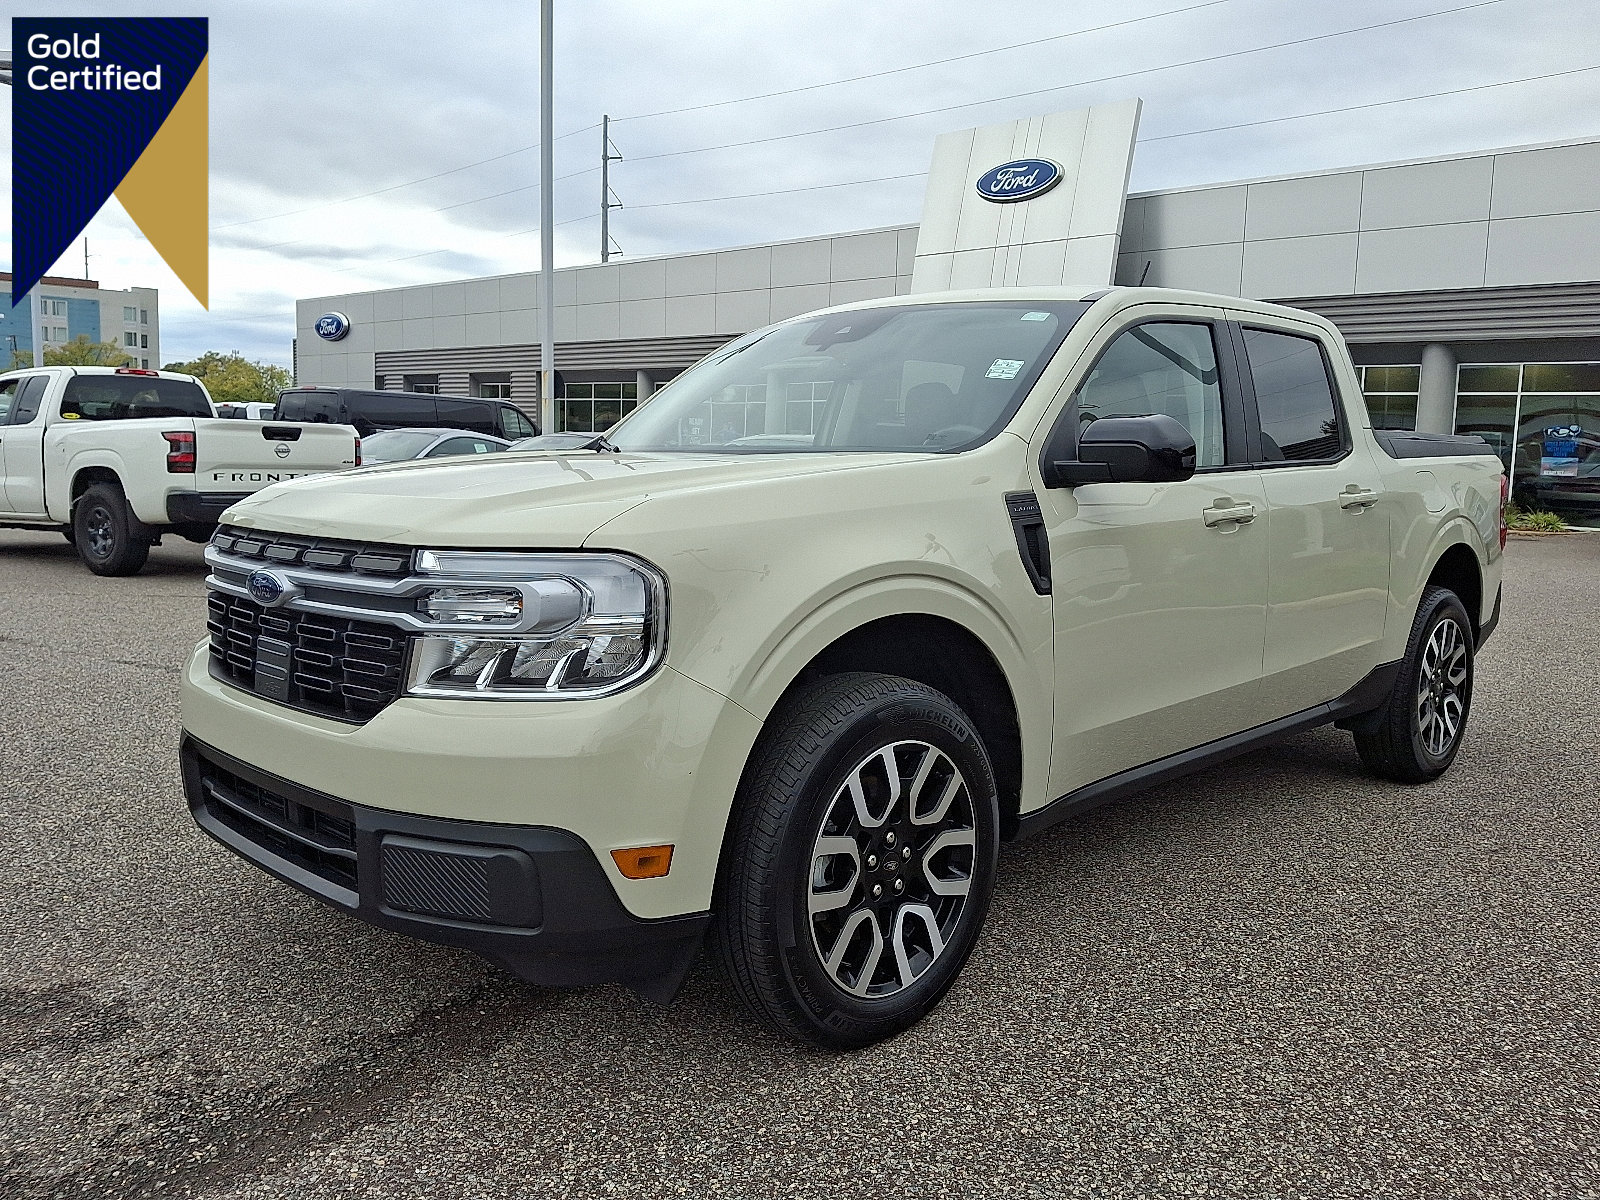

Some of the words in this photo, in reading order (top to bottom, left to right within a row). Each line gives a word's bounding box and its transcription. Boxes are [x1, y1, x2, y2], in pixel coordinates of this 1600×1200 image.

[990, 166, 1040, 192] Ford
[319, 318, 337, 334] Ford
[213, 473, 309, 482] FRONT
